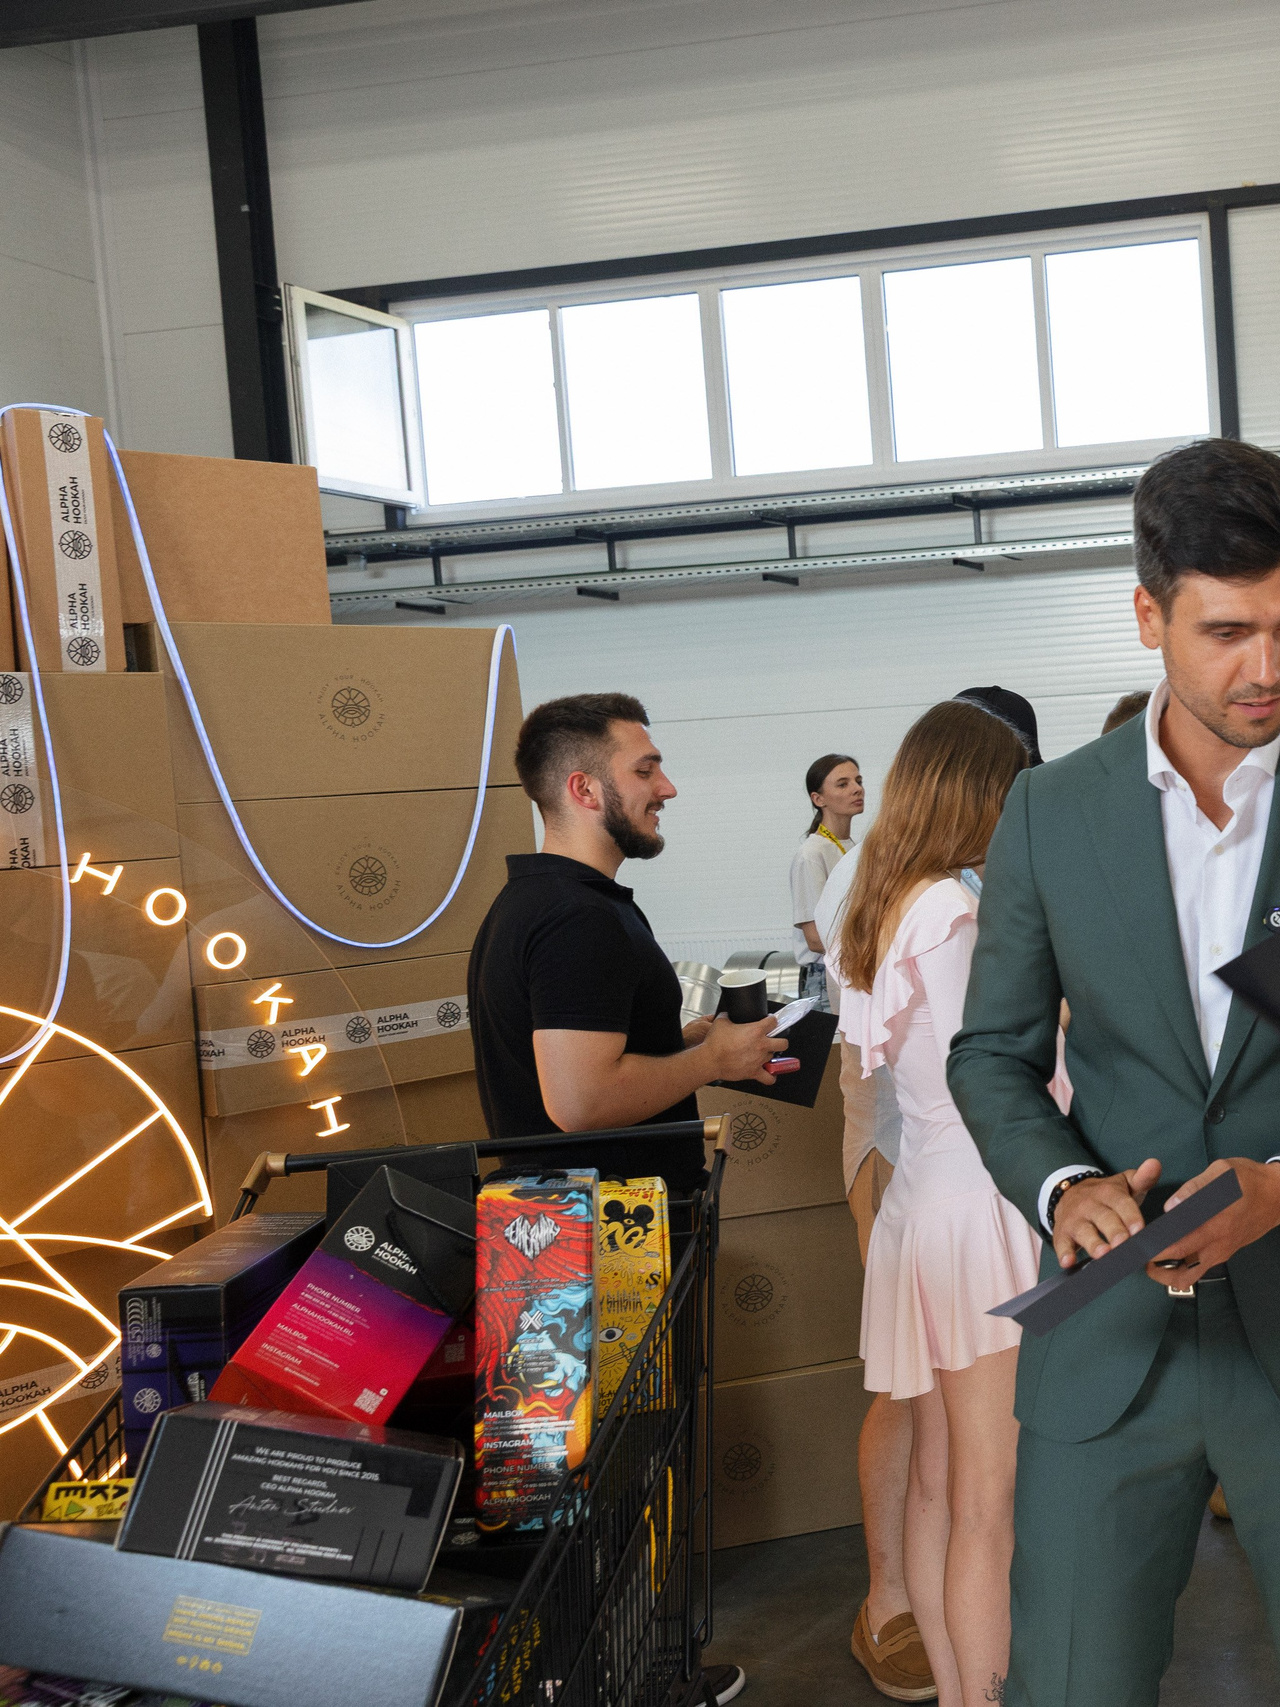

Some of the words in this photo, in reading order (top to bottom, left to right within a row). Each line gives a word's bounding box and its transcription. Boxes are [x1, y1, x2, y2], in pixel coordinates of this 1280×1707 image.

[59, 485, 70, 523] ALPHA
[69, 476, 82, 524] HOOKAH
[67, 592, 78, 629] ALPHA
[78, 583, 90, 631] HOOKAH
[318, 713, 346, 740] ALPHA
[352, 713, 386, 742] HOOKAH
[9, 728, 22, 777] HOOKAH
[336, 883, 362, 910] ALPHA
[369, 880, 402, 911] HOOKAH
[377, 1013, 410, 1024] ALPHA
[377, 1020, 419, 1034] HOOKAH
[281, 1026, 316, 1039] ALPHA
[281, 1034, 326, 1048] HOOKAH
[374, 1248, 418, 1275] HOOKAH
[307, 1282, 332, 1299] PHONE
[332, 1295, 361, 1313] NUMBER
[292, 1303, 354, 1337] ALPHAHOOKAH.RU
[277, 1322, 309, 1341] MAILBOX
[261, 1342, 302, 1365] INSTAGRAM
[484, 1410, 525, 1419] MAILBOX
[483, 1439, 535, 1449] INSTAGRAM
[231, 1453, 266, 1465] AMAZING
[287, 1451, 314, 1462] PROUD
[326, 1457, 362, 1470] PRODUCE
[483, 1464, 515, 1474] PHONE
[517, 1461, 557, 1472] NUMBER
[260, 1481, 277, 1490] CEO
[277, 1484, 303, 1494] ALPHA
[303, 1487, 337, 1499] HOOKAH
